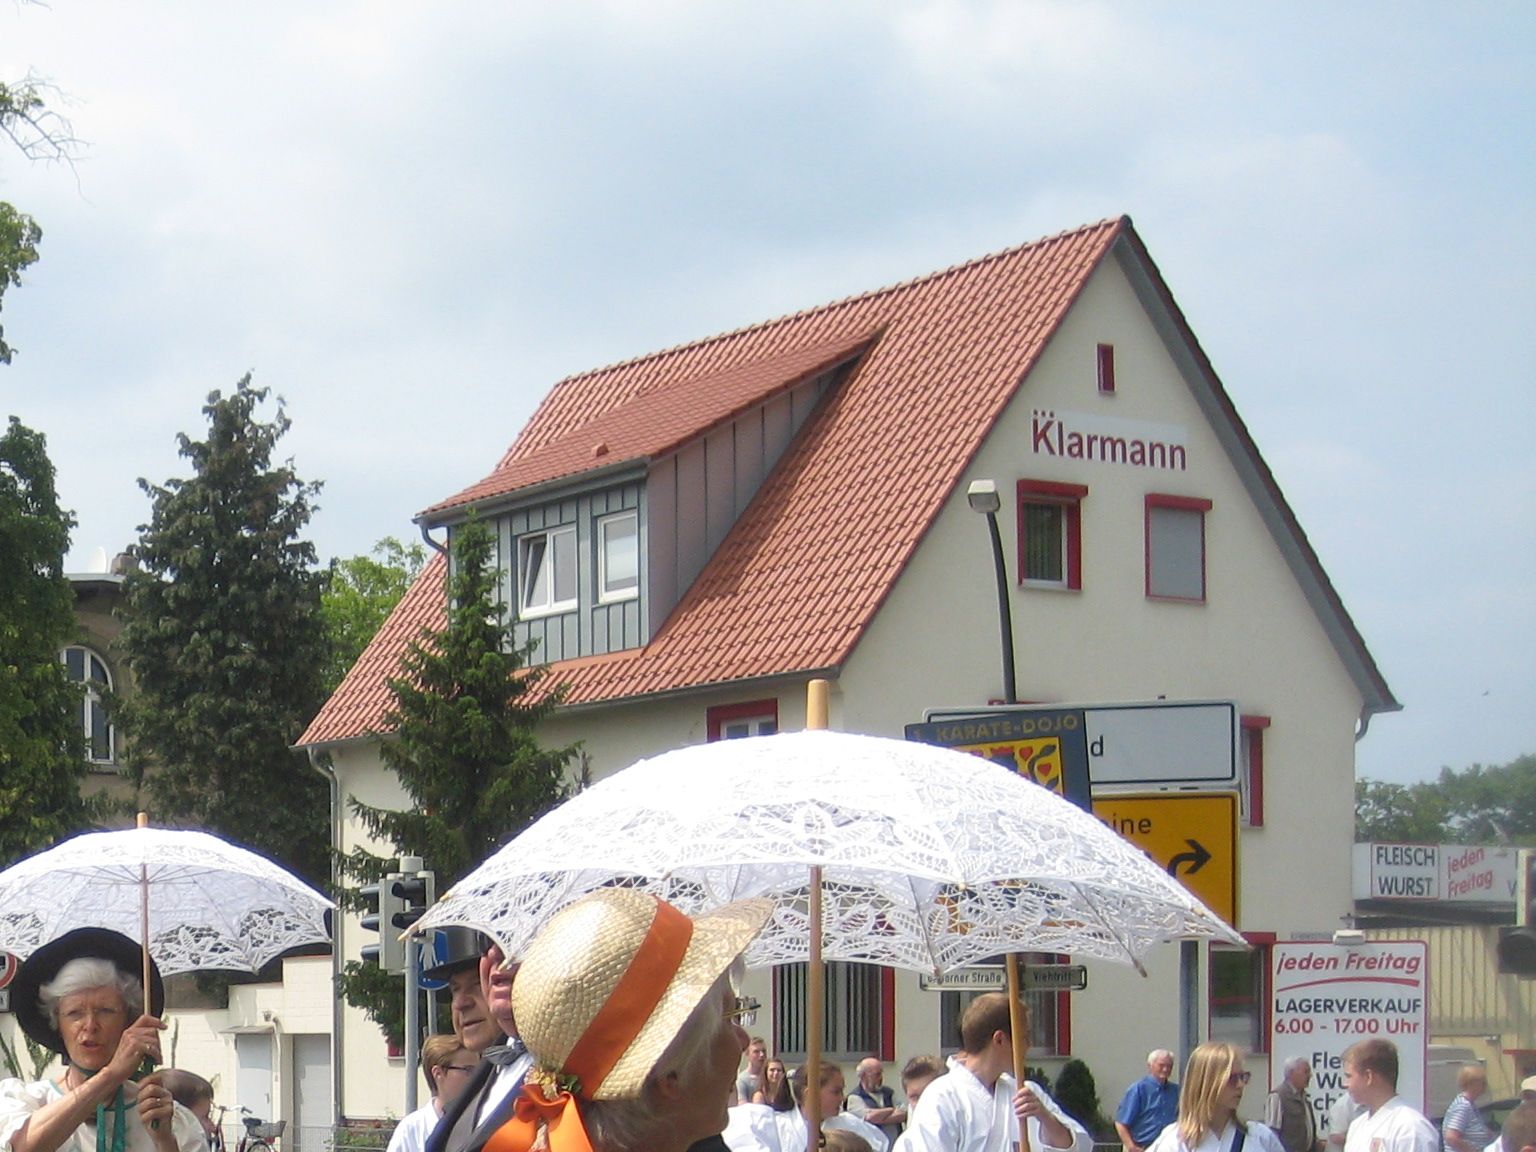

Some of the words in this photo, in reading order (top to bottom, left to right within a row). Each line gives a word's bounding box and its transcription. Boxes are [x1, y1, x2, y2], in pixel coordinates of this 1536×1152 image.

[1032, 417, 1187, 471] Klarmann
[937, 714, 1078, 742] KARATE-DOJO
[1376, 846, 1435, 867] FLEISCH
[1448, 848, 1485, 879] jeden
[1378, 876, 1433, 896] WURST
[1448, 869, 1493, 899] Freitag
[1276, 953, 1339, 975] jeden
[1345, 952, 1421, 974] Freitag
[1275, 998, 1421, 1014] LAGERVERKAUF
[1275, 1018, 1314, 1034] 6.00
[1334, 1018, 1379, 1034] 17.00
[1386, 1018, 1420, 1034] Uhr
